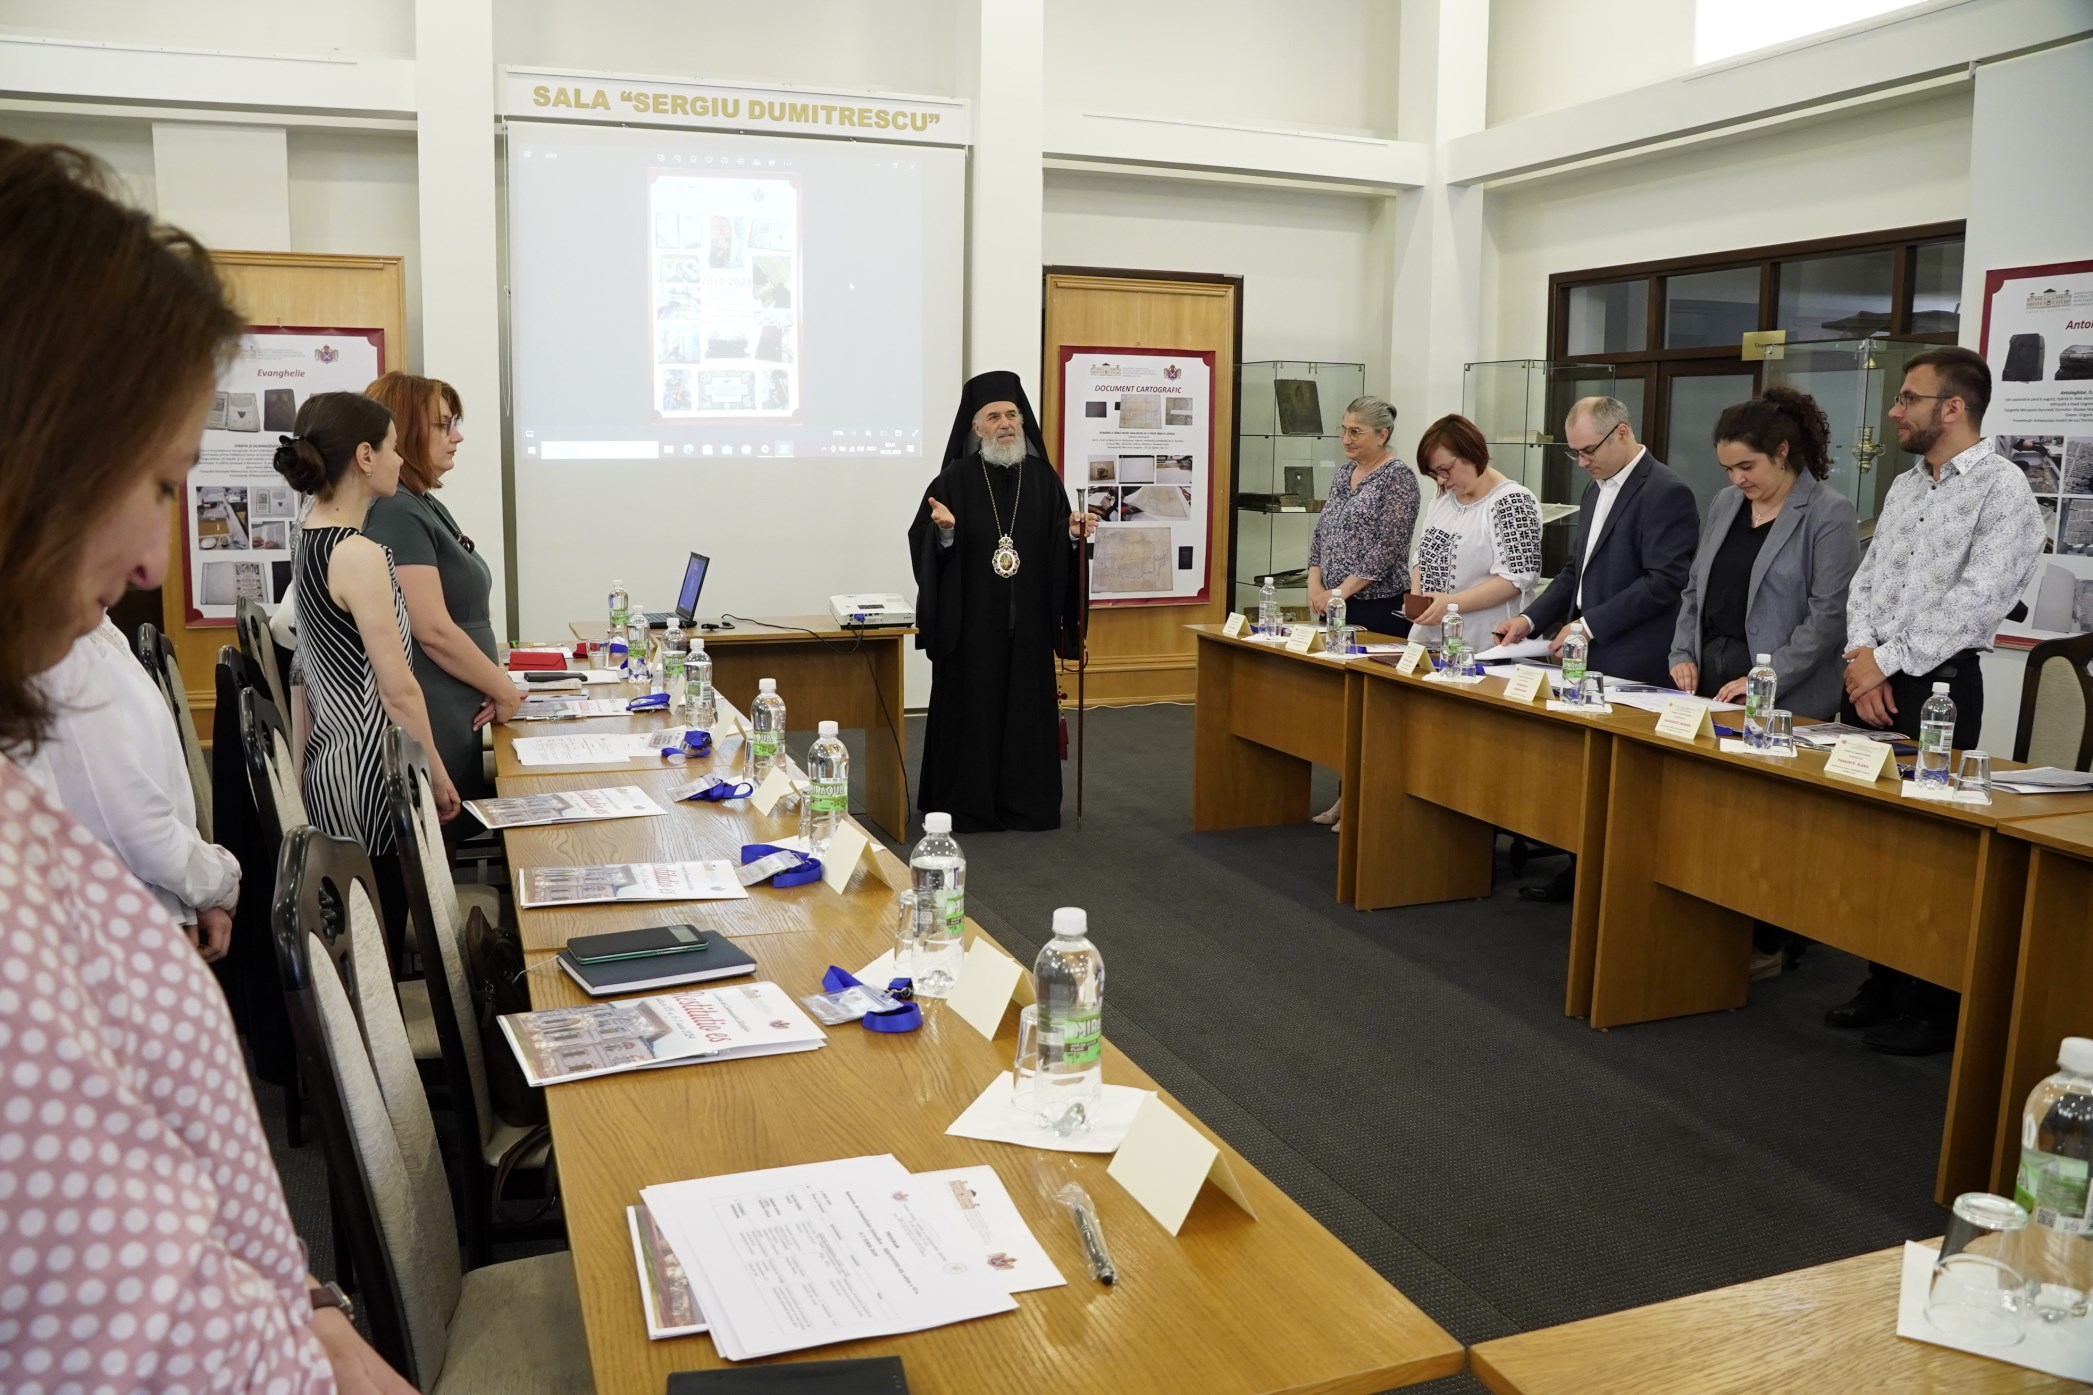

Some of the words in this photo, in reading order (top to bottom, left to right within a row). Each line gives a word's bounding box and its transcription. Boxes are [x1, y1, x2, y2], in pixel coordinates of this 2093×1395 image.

[533, 85, 611, 111] SALA
[257, 368, 306, 378] Evanghelie
[1094, 384, 1135, 393] DOCUMENT
[1136, 385, 1183, 394] CARTOGRAFIC
